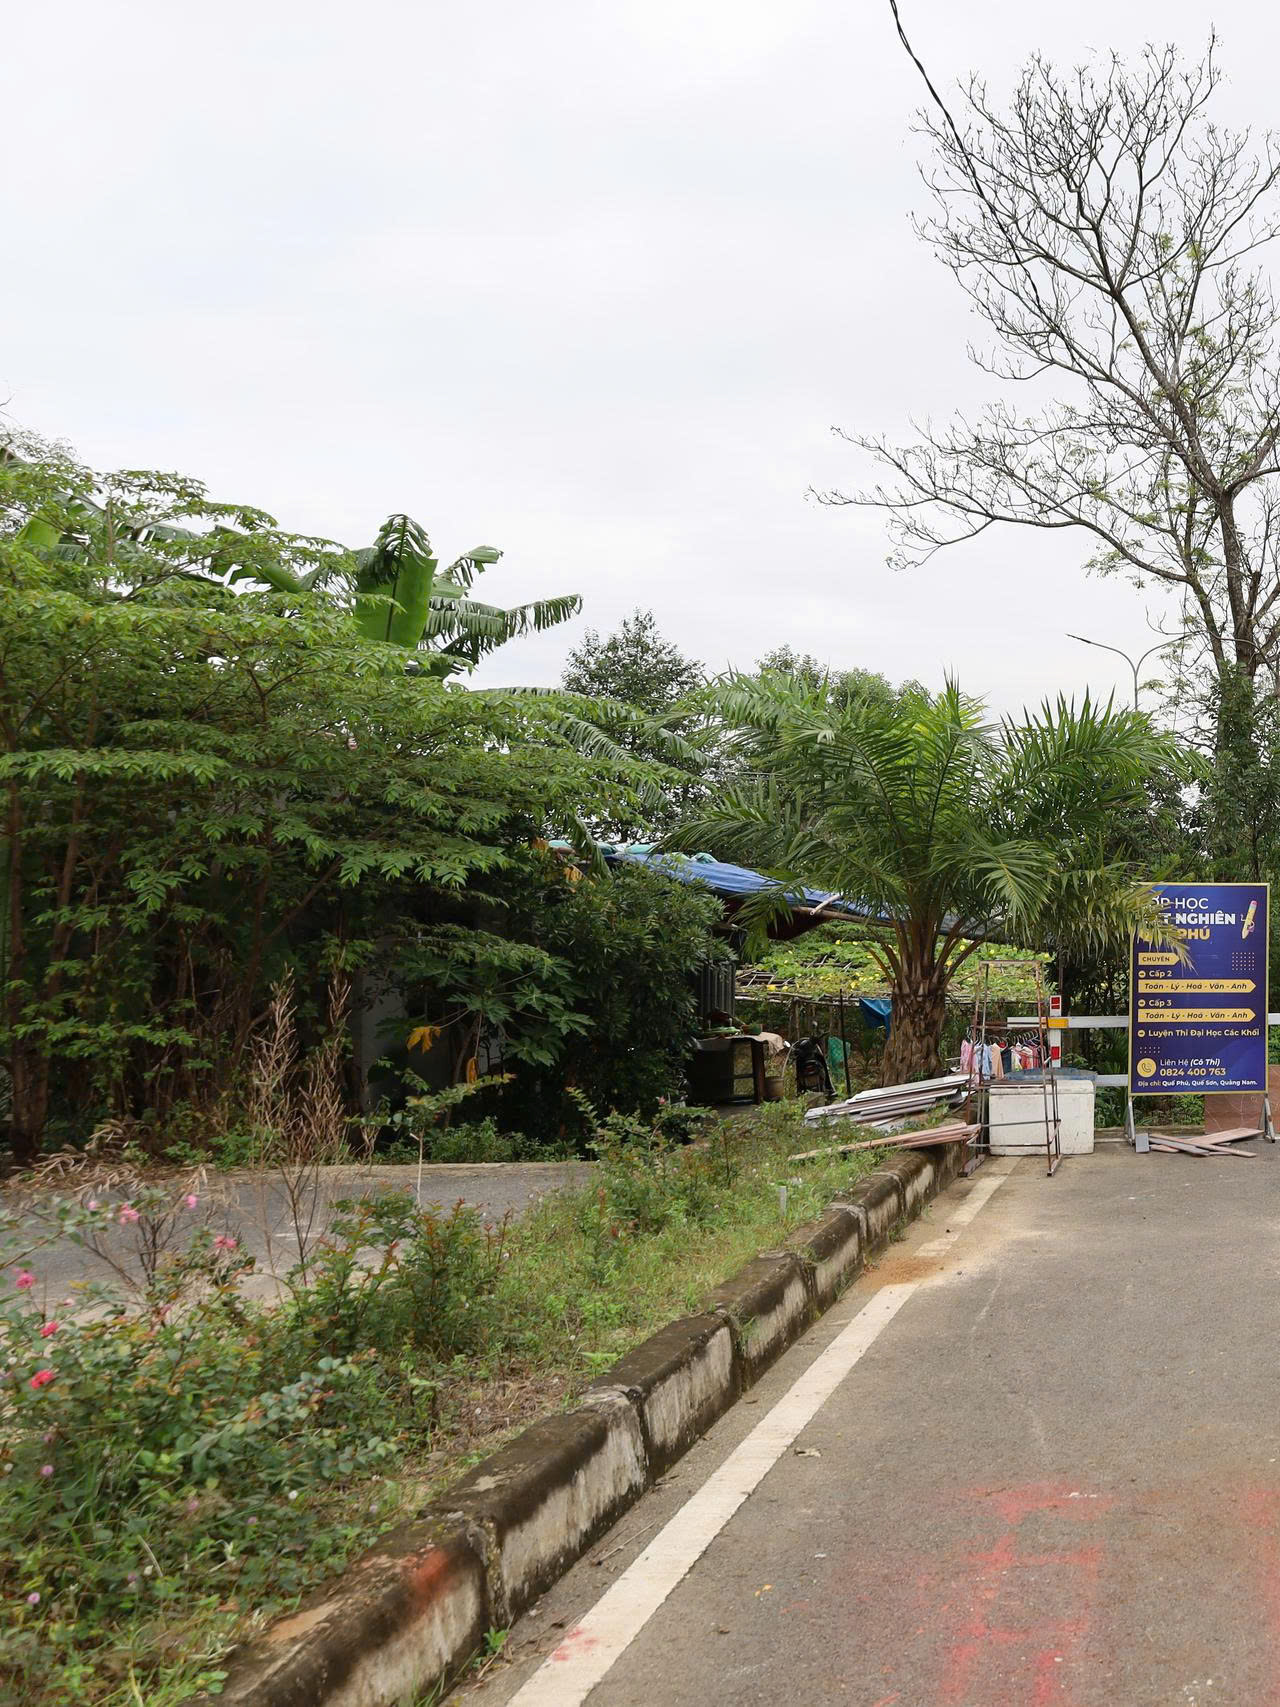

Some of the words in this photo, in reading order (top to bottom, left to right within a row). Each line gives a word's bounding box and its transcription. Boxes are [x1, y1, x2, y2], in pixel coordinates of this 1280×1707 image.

[1175, 897, 1208, 912] HỌC
[1175, 910, 1235, 925] NGHIÊN
[1176, 925, 1210, 939] PHÚ
[1149, 970, 1165, 978] Cấp
[1171, 983, 1180, 991] Lý
[1149, 999, 1165, 1007] Cấp
[1171, 1012, 1180, 1020] Lý
[1148, 1029, 1173, 1038] Luyện
[1190, 1029, 1204, 1037] Đại
[1206, 1029, 1222, 1037] Học
[1224, 1028, 1239, 1036] Các
[1241, 1028, 1260, 1036] Khối
[1160, 1068, 1185, 1076] 0824
[1187, 1068, 1206, 1076] 400
[1209, 1067, 1226, 1076] 763
